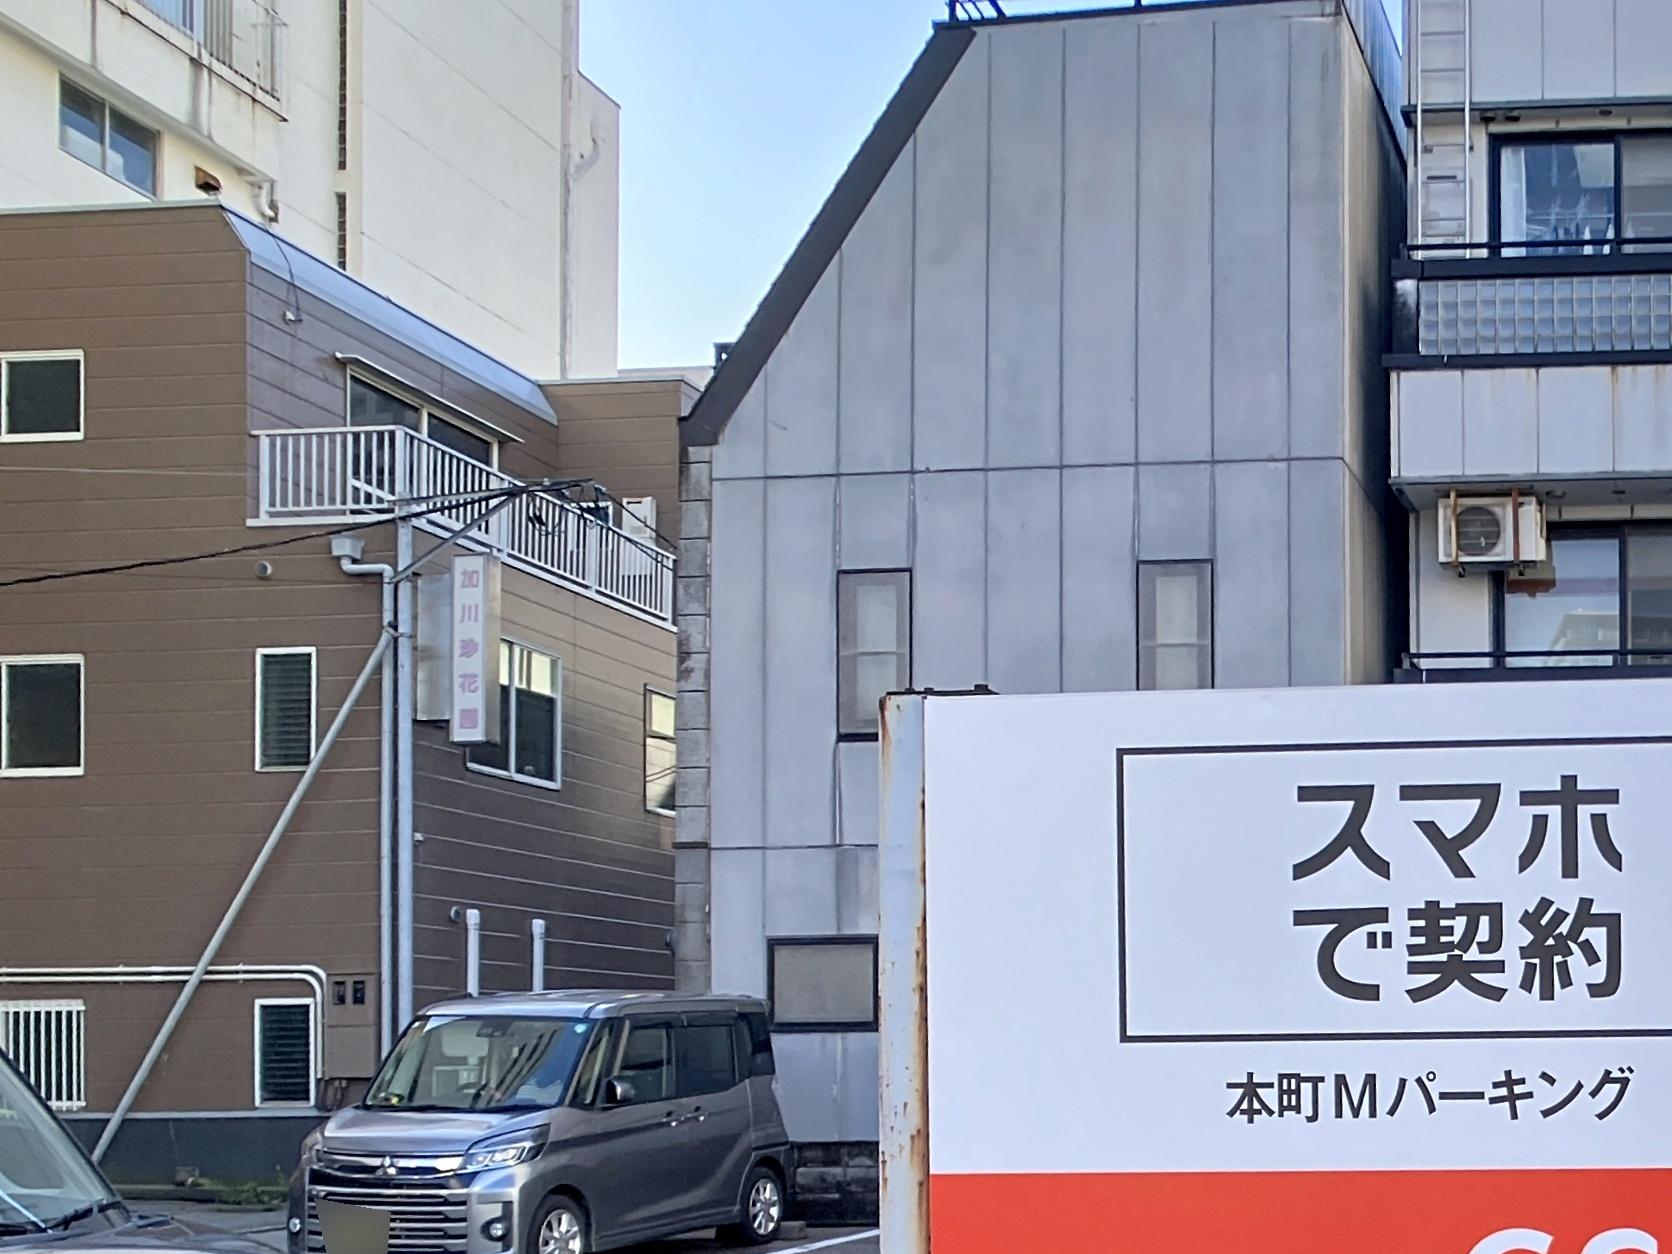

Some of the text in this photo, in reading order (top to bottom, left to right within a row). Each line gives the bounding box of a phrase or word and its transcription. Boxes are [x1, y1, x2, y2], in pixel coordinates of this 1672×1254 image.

[1293, 775, 1622, 881] スマホ
[1293, 897, 1621, 1003] で契約
[1226, 1066, 1634, 1124] 本町Mパーキング
